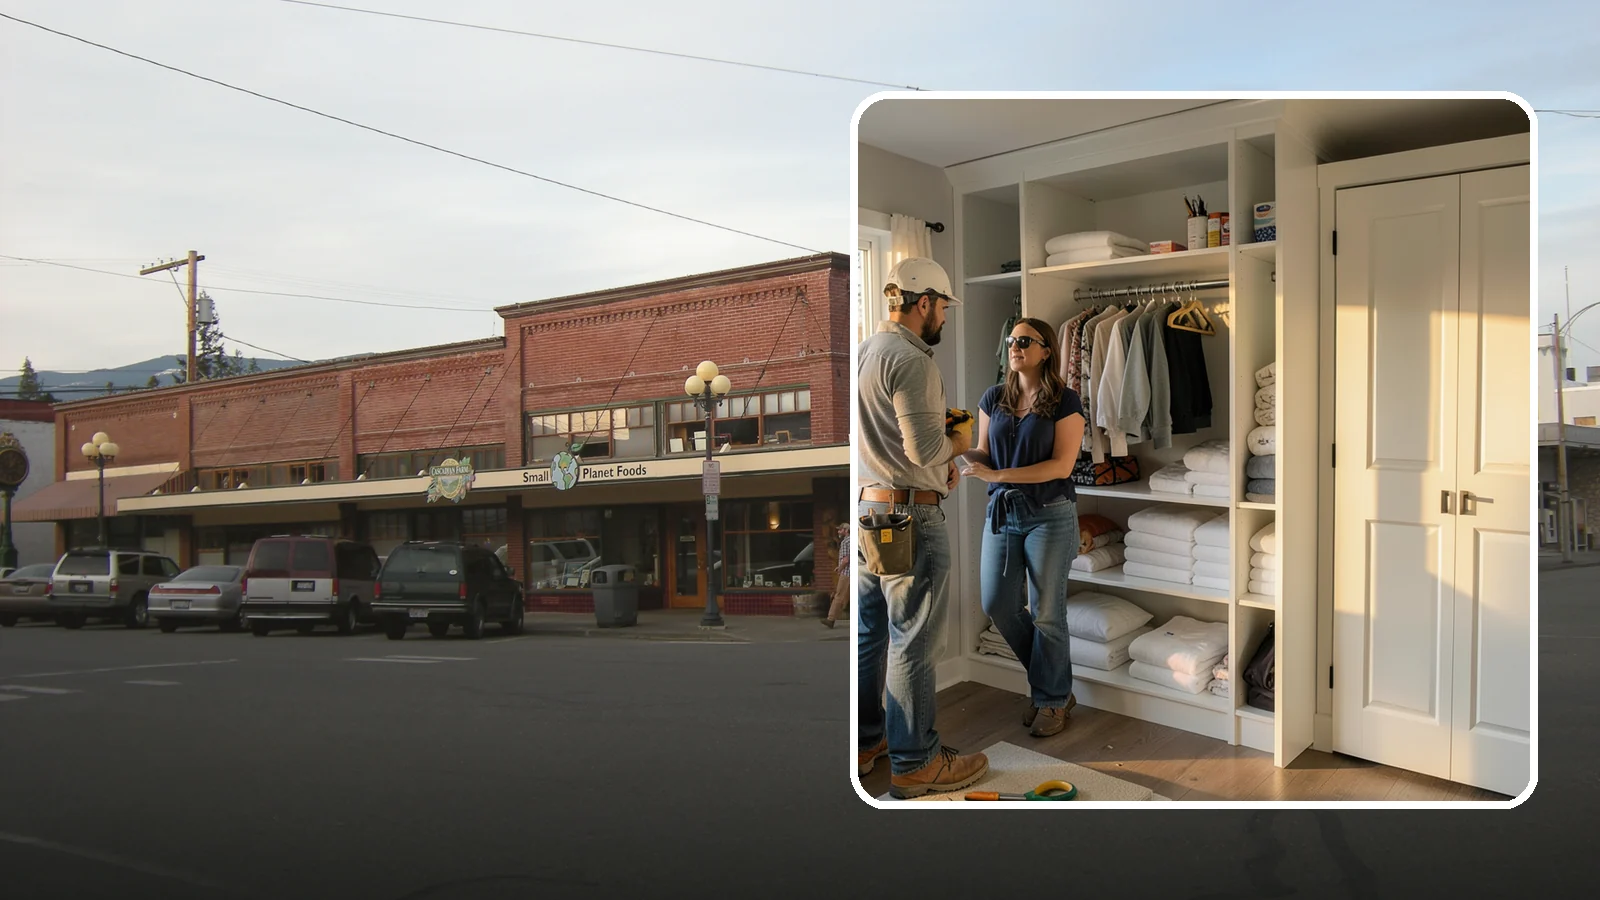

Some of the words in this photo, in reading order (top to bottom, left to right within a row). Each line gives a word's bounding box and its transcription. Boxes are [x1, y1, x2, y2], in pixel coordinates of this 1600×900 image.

[523, 471, 549, 483] Small
[583, 467, 614, 479] Planet
[617, 464, 647, 477] Foods
